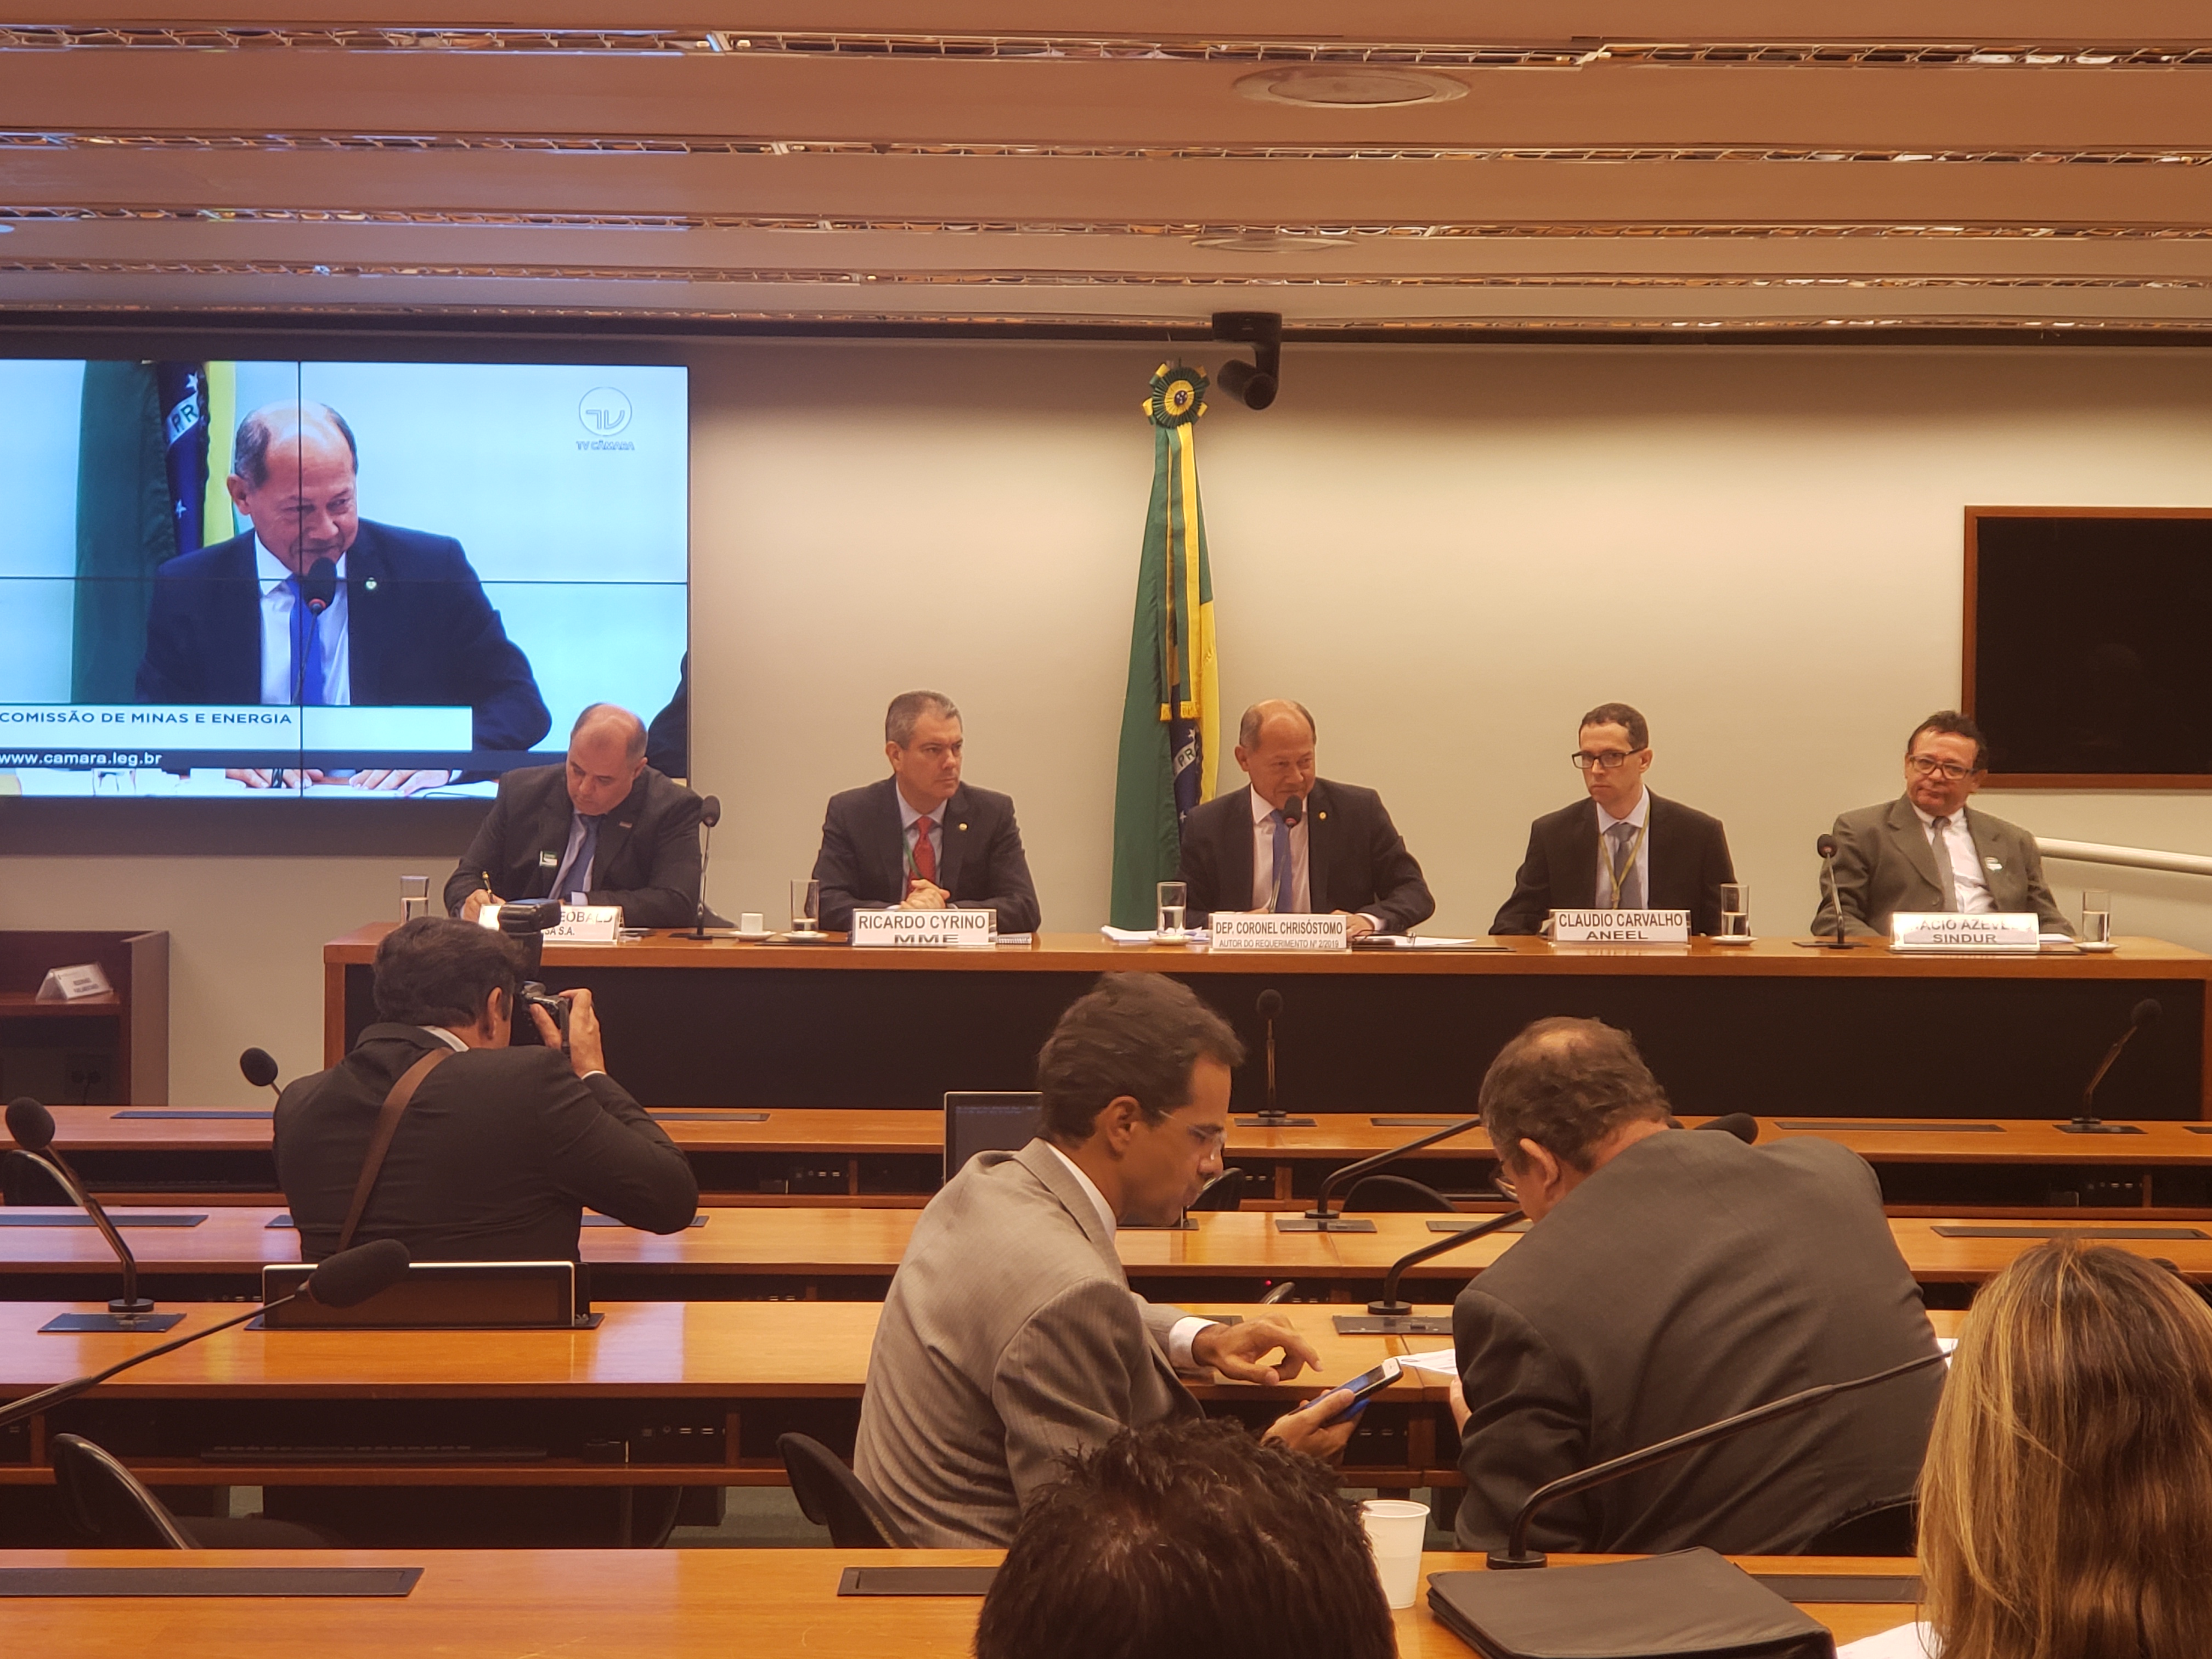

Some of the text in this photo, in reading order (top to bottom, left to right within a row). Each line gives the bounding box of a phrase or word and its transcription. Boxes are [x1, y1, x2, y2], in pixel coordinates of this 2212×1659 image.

[576, 439, 635, 450] TV CÂMARA
[0, 710, 292, 724] COMISSÃO DE MINAS E ENERGIA
[0, 753, 162, 766] www.camara.leg.br
[859, 916, 985, 929] RICARDO CYRINO
[1216, 919, 1343, 934] DEP. CORONEL CHRISÓSTOMO
[1559, 913, 1683, 927] CLAUDIO CARVALHO
[894, 934, 958, 943] MME
[1586, 930, 1649, 939] ANEEL
[1933, 934, 1997, 943] SINDUR
